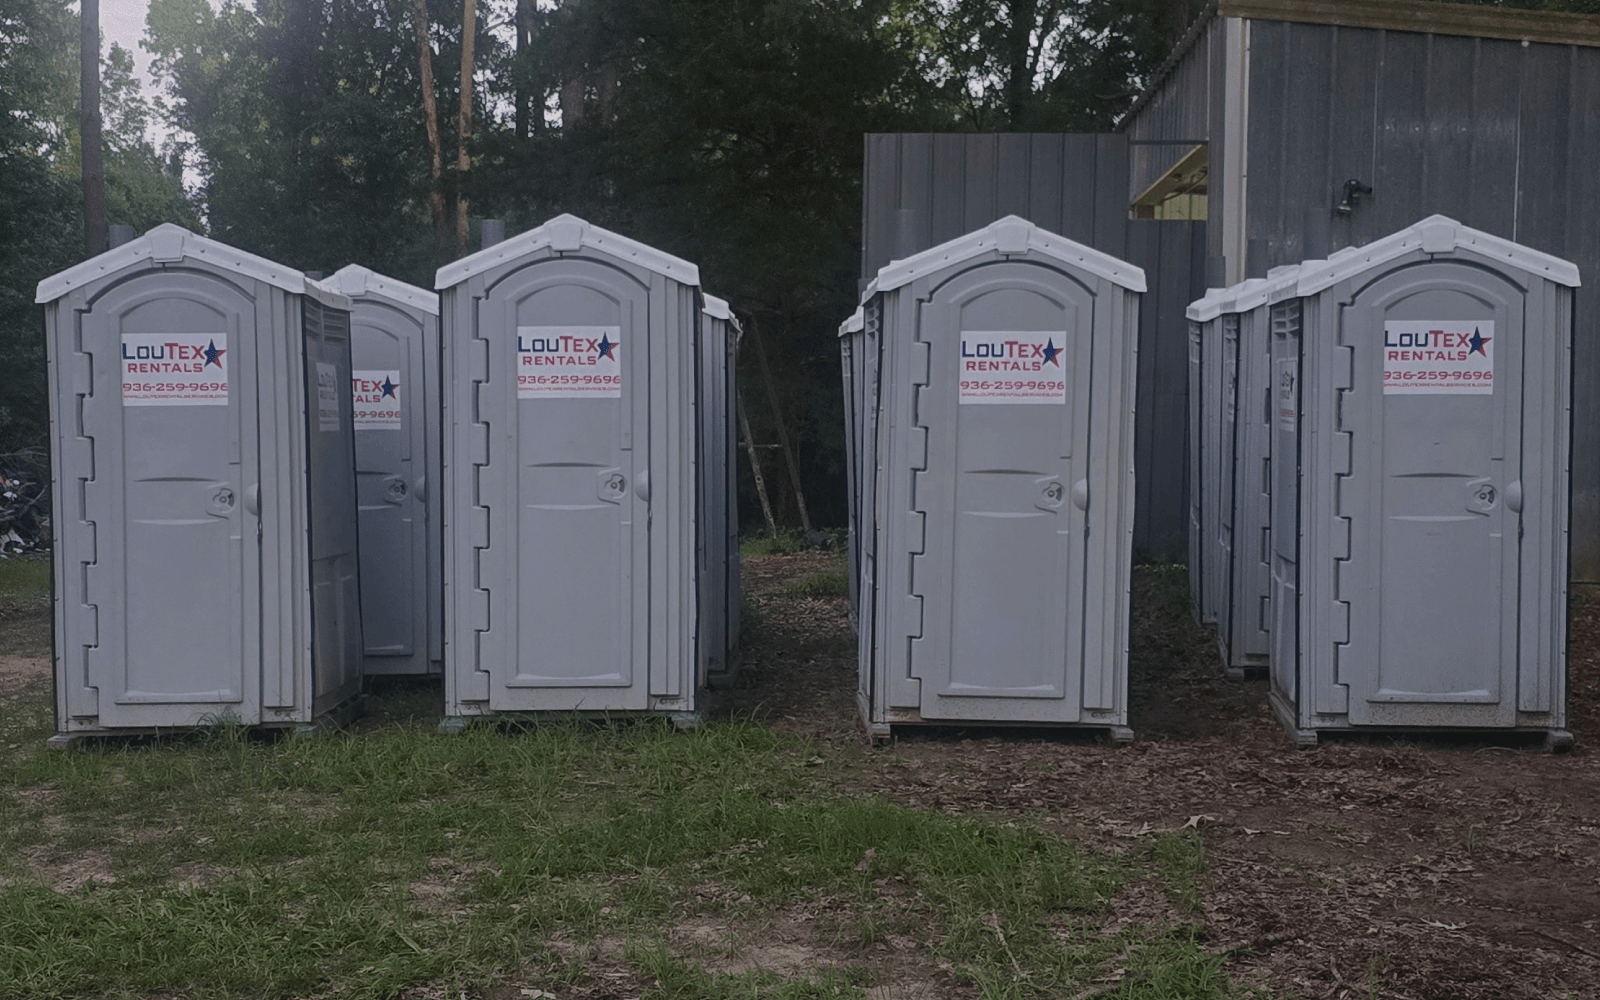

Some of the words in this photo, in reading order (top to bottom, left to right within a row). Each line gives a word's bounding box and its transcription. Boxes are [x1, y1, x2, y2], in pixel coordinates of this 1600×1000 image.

[522, 355, 597, 366] RENTALS
[1388, 351, 1468, 361] RENTALS
[127, 363, 203, 373] RENTALS
[966, 361, 1041, 371] RENTALS
[518, 375, 621, 384] 936-259-9696
[1384, 371, 1493, 380] 936-259-9696
[122, 383, 228, 392] 936-259-9696
[960, 381, 1065, 390] 936-259-9696
